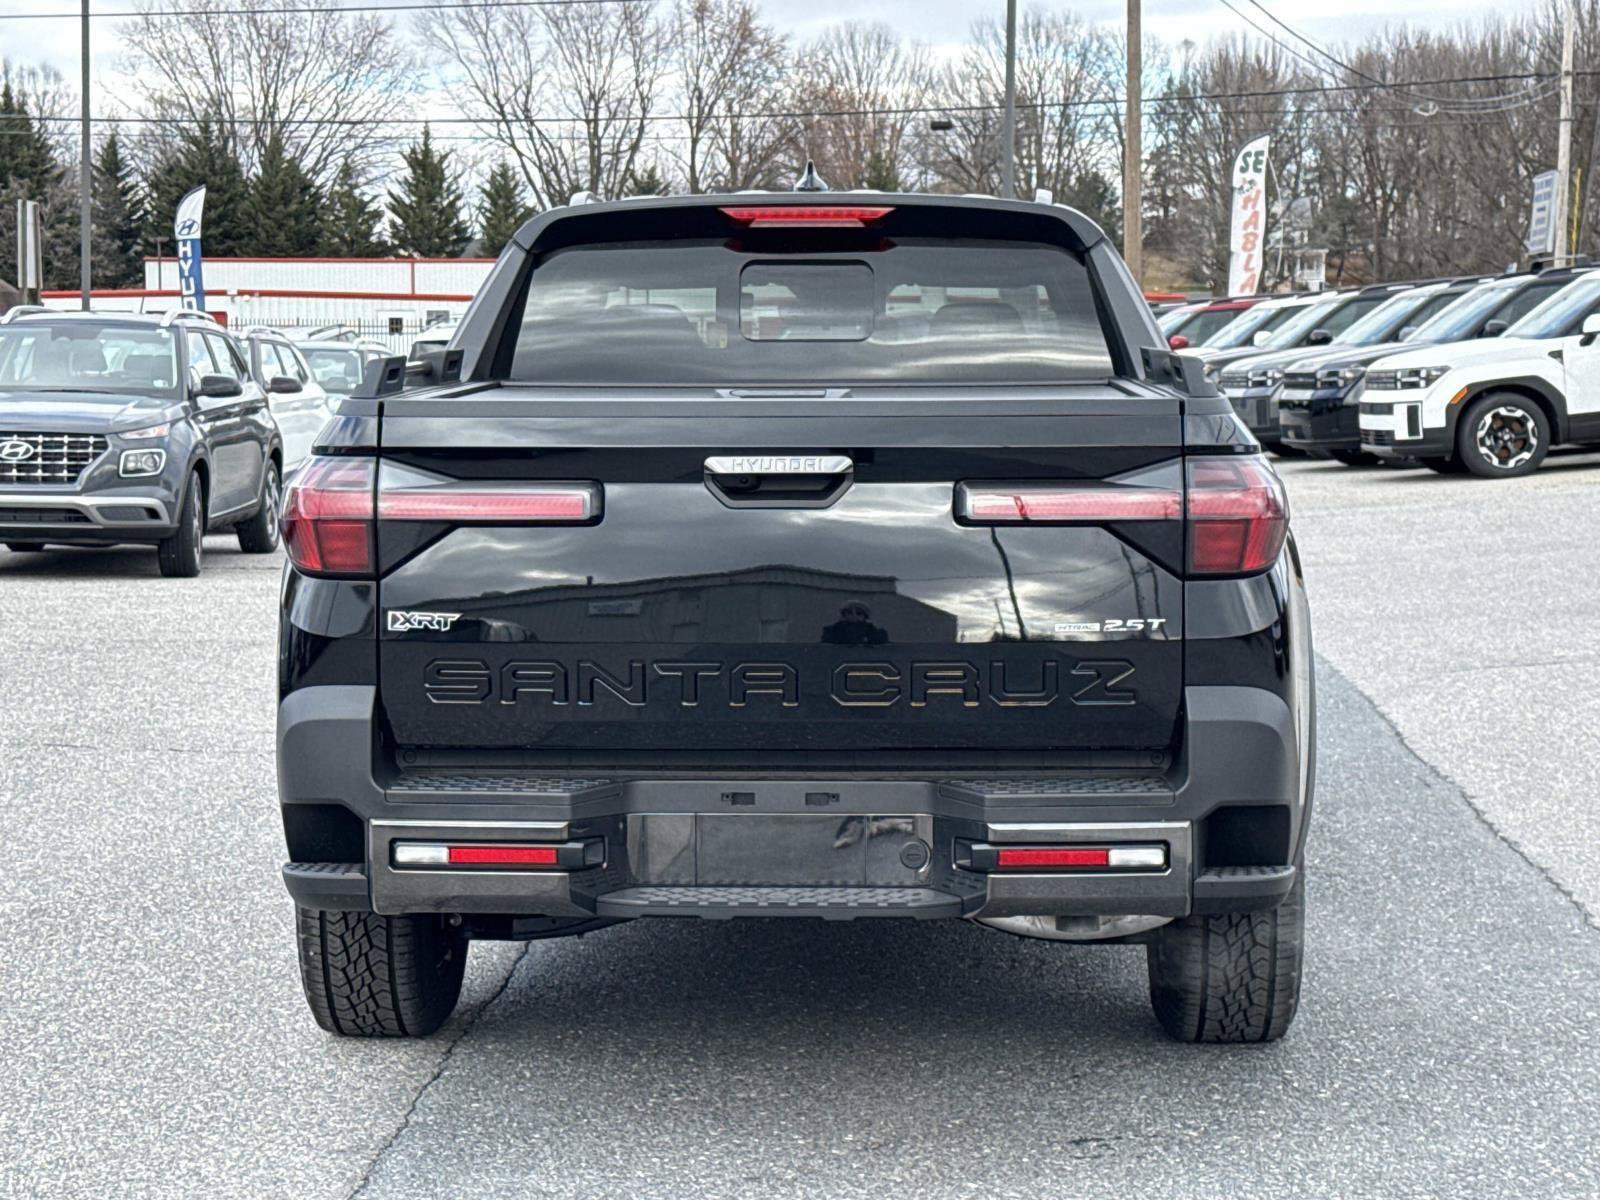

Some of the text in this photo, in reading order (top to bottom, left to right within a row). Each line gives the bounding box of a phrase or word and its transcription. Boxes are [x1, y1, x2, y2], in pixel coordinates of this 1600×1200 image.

[1239, 150, 1265, 174] SE
[1239, 189, 1260, 293] HABLA
[732, 457, 823, 472] HYUNDAI
[388, 610, 463, 632] XRT
[424, 658, 1138, 708] SANTA CRUZ
